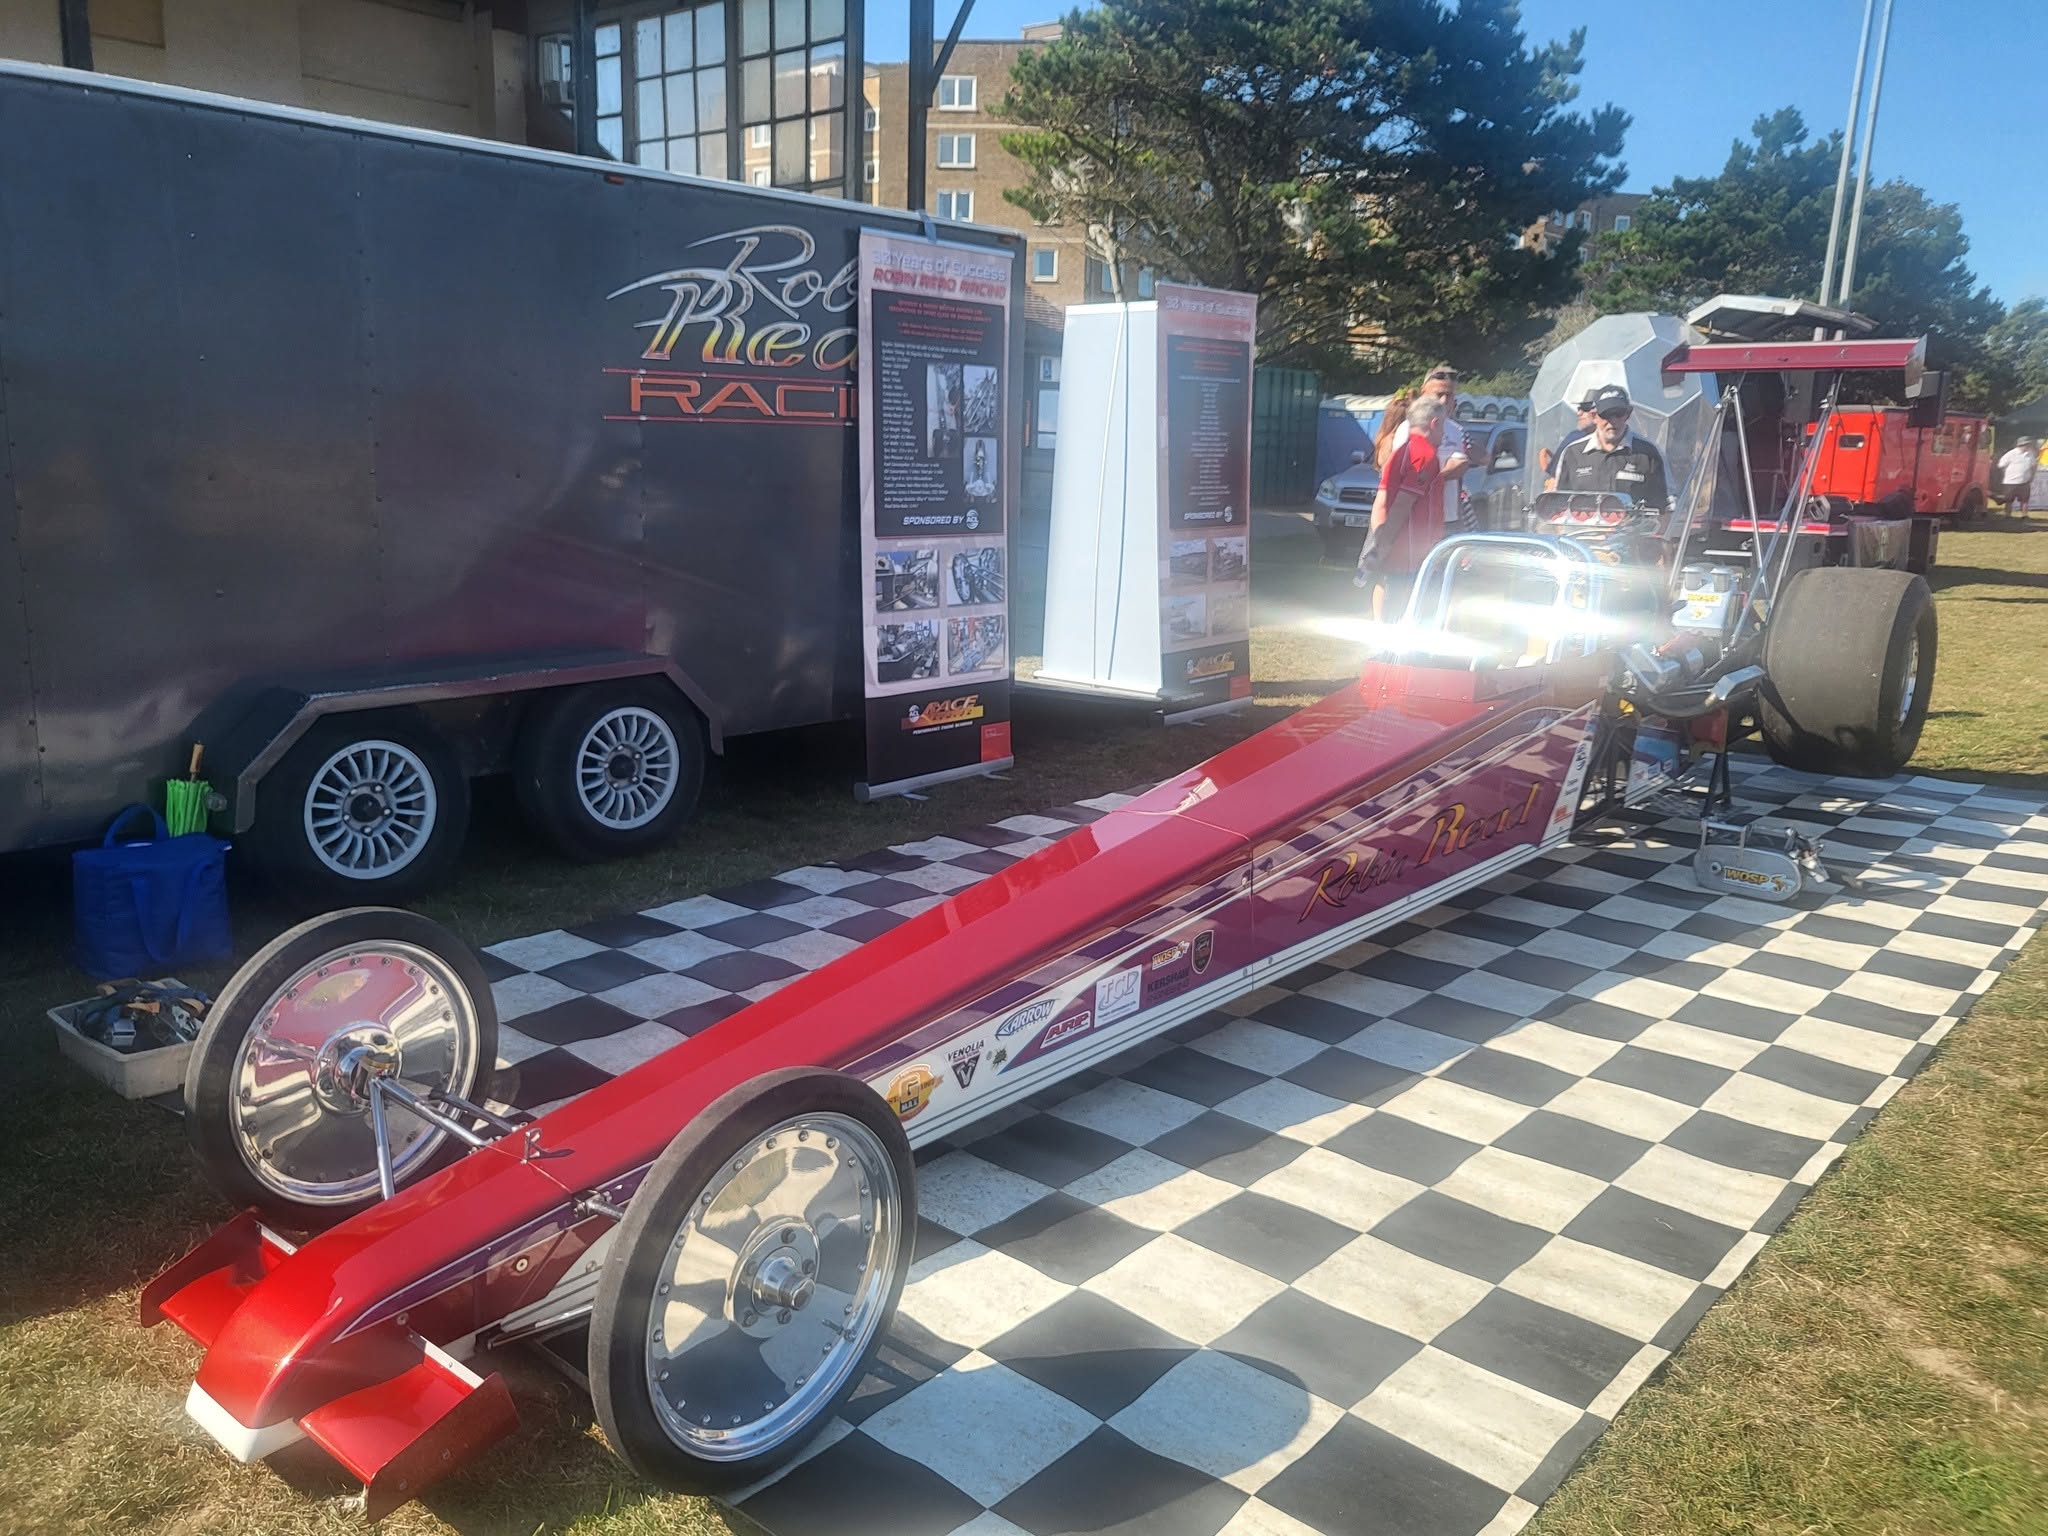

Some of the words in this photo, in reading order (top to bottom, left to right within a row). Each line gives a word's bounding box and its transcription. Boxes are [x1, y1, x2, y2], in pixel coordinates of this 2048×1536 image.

[894, 249, 933, 272] Years
[935, 256, 948, 273] of
[952, 259, 1006, 281] Success
[873, 268, 917, 288] ROBIN
[903, 516, 952, 525] SPONSORED
[952, 515, 965, 524] BY
[1298, 848, 1409, 924] Robin
[1415, 781, 1540, 869] Read
[1726, 869, 1770, 885] WOSP
[1147, 967, 1190, 992] KERSHAW
[1009, 1000, 1055, 1033] ARROW
[1046, 1013, 1089, 1041] ARP
[947, 1039, 985, 1061] VENOLIA
